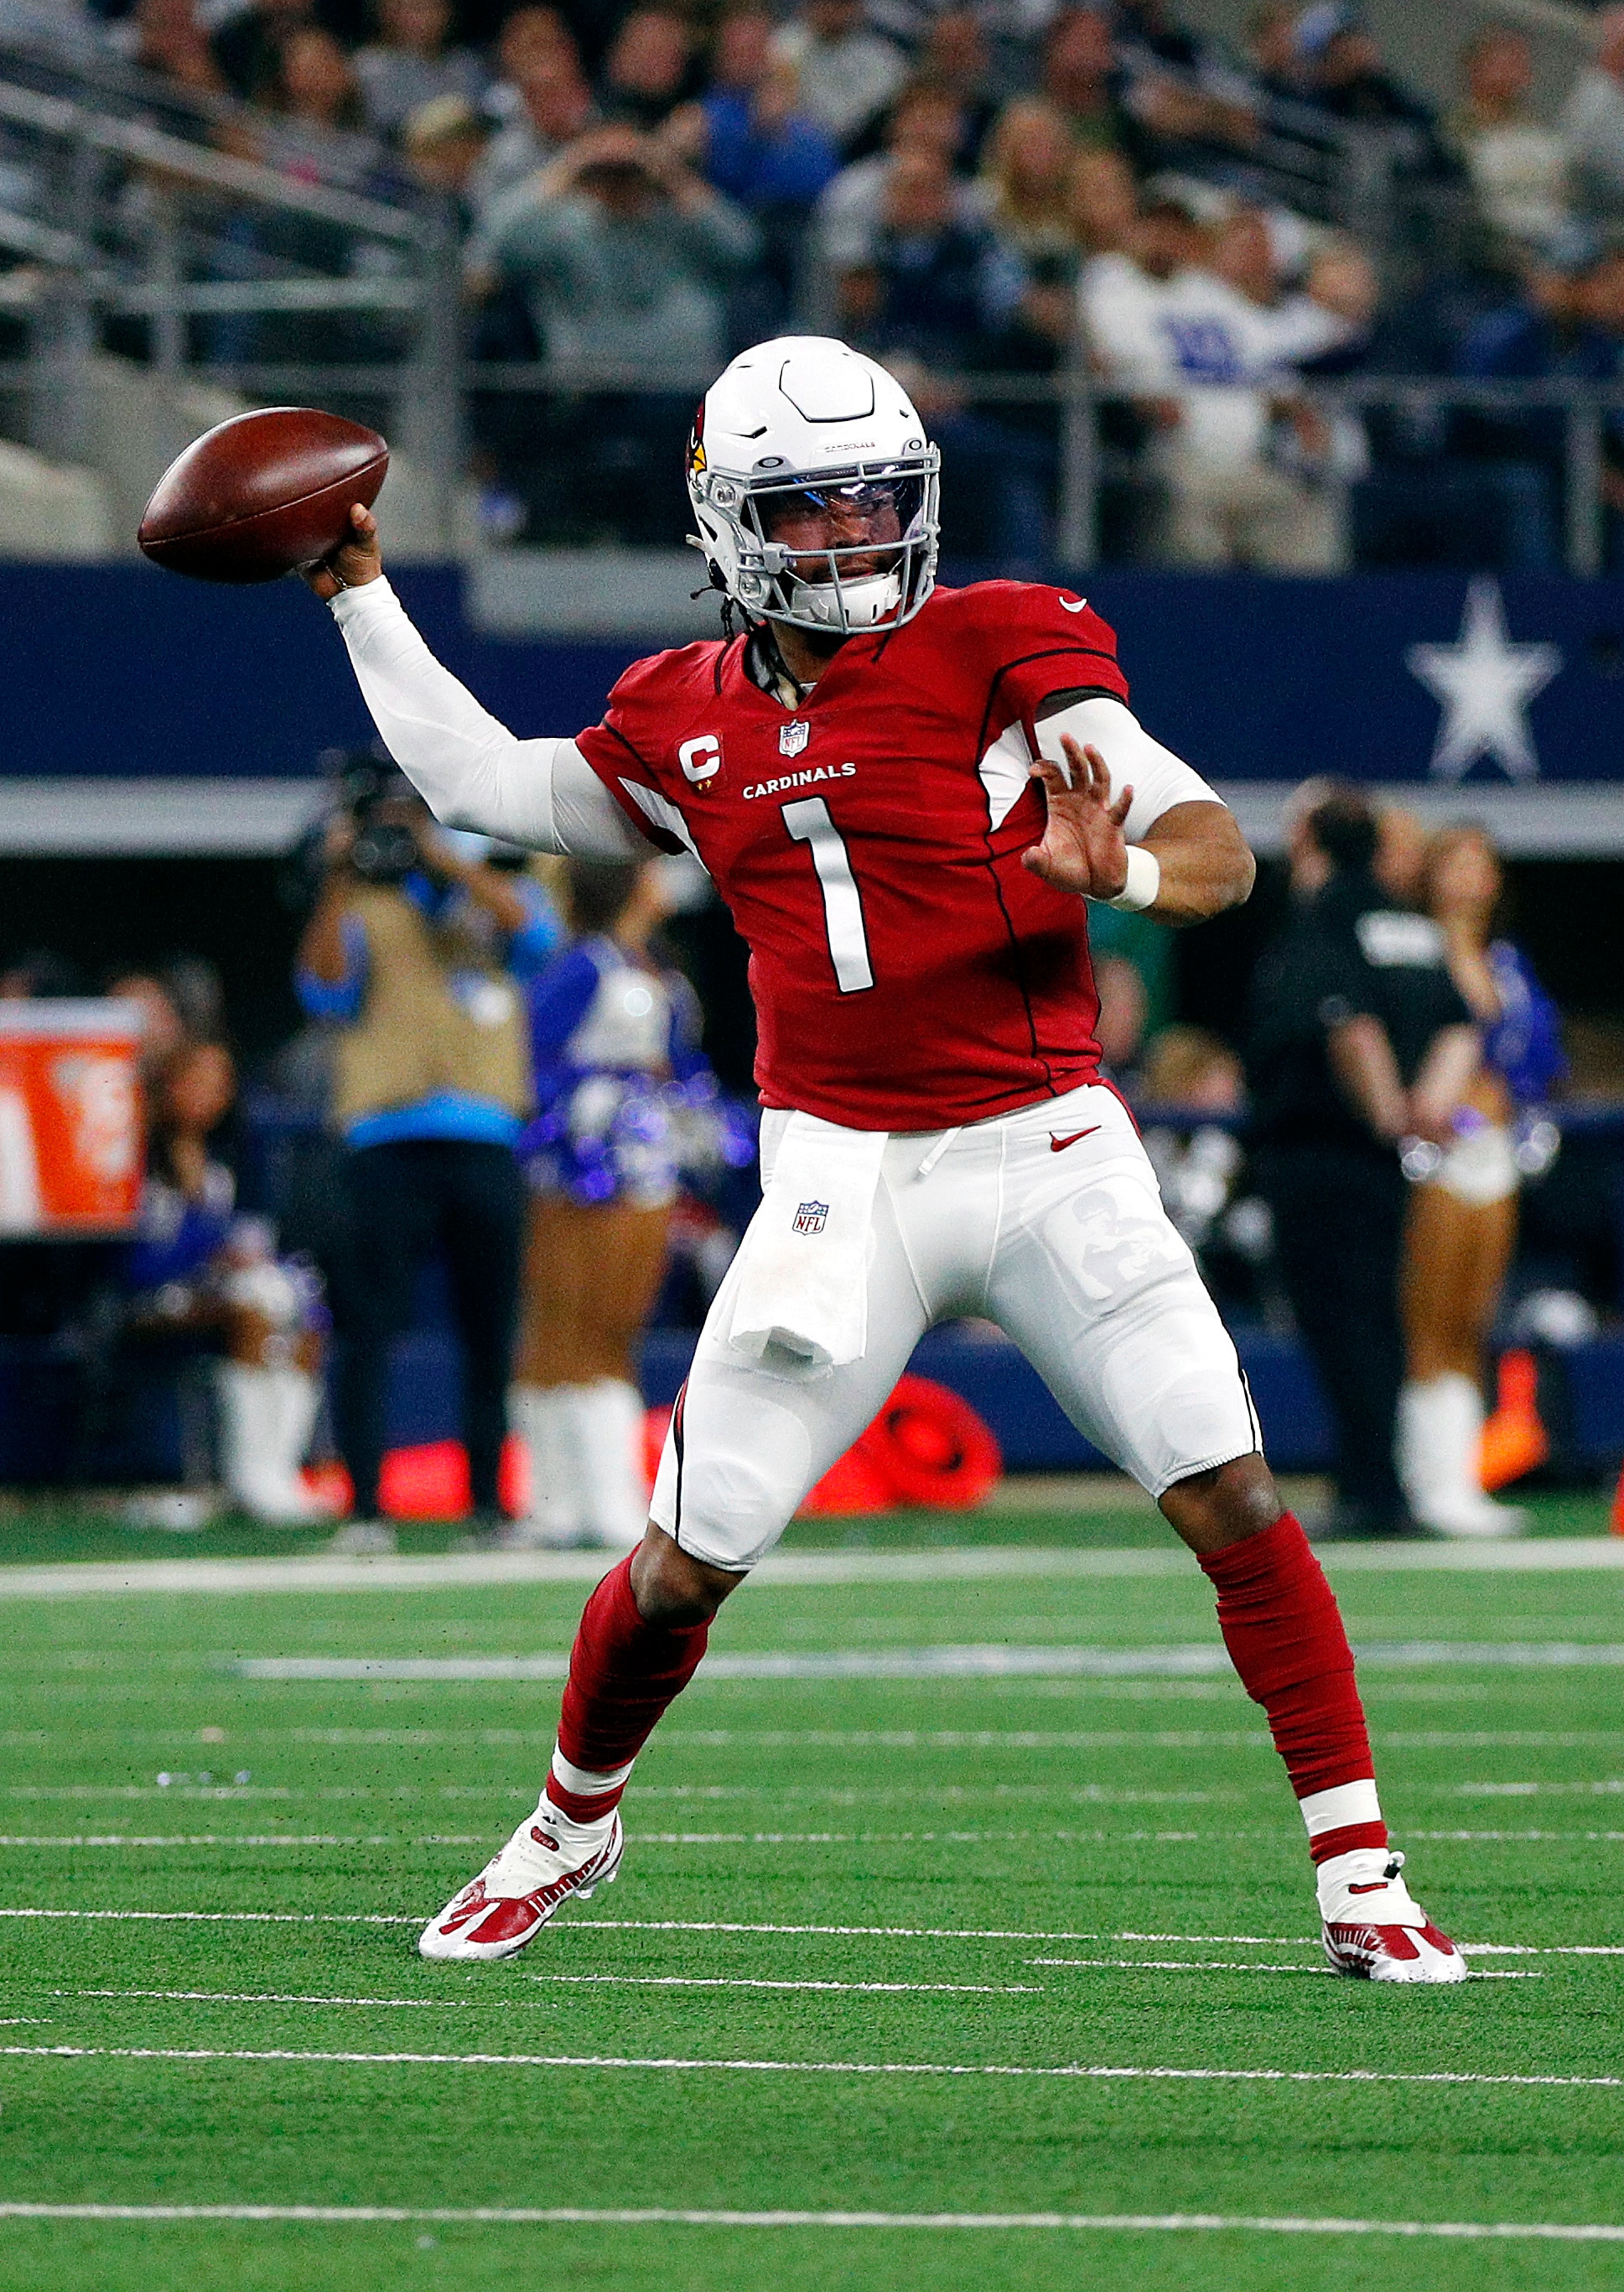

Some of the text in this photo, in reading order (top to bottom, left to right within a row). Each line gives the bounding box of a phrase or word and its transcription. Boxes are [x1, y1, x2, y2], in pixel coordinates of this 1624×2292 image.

[678, 734, 720, 782] C
[784, 736, 802, 750] NFL
[743, 762, 857, 799] CARDINALS
[781, 796, 874, 993] 1
[796, 1215, 821, 1232] NFL
